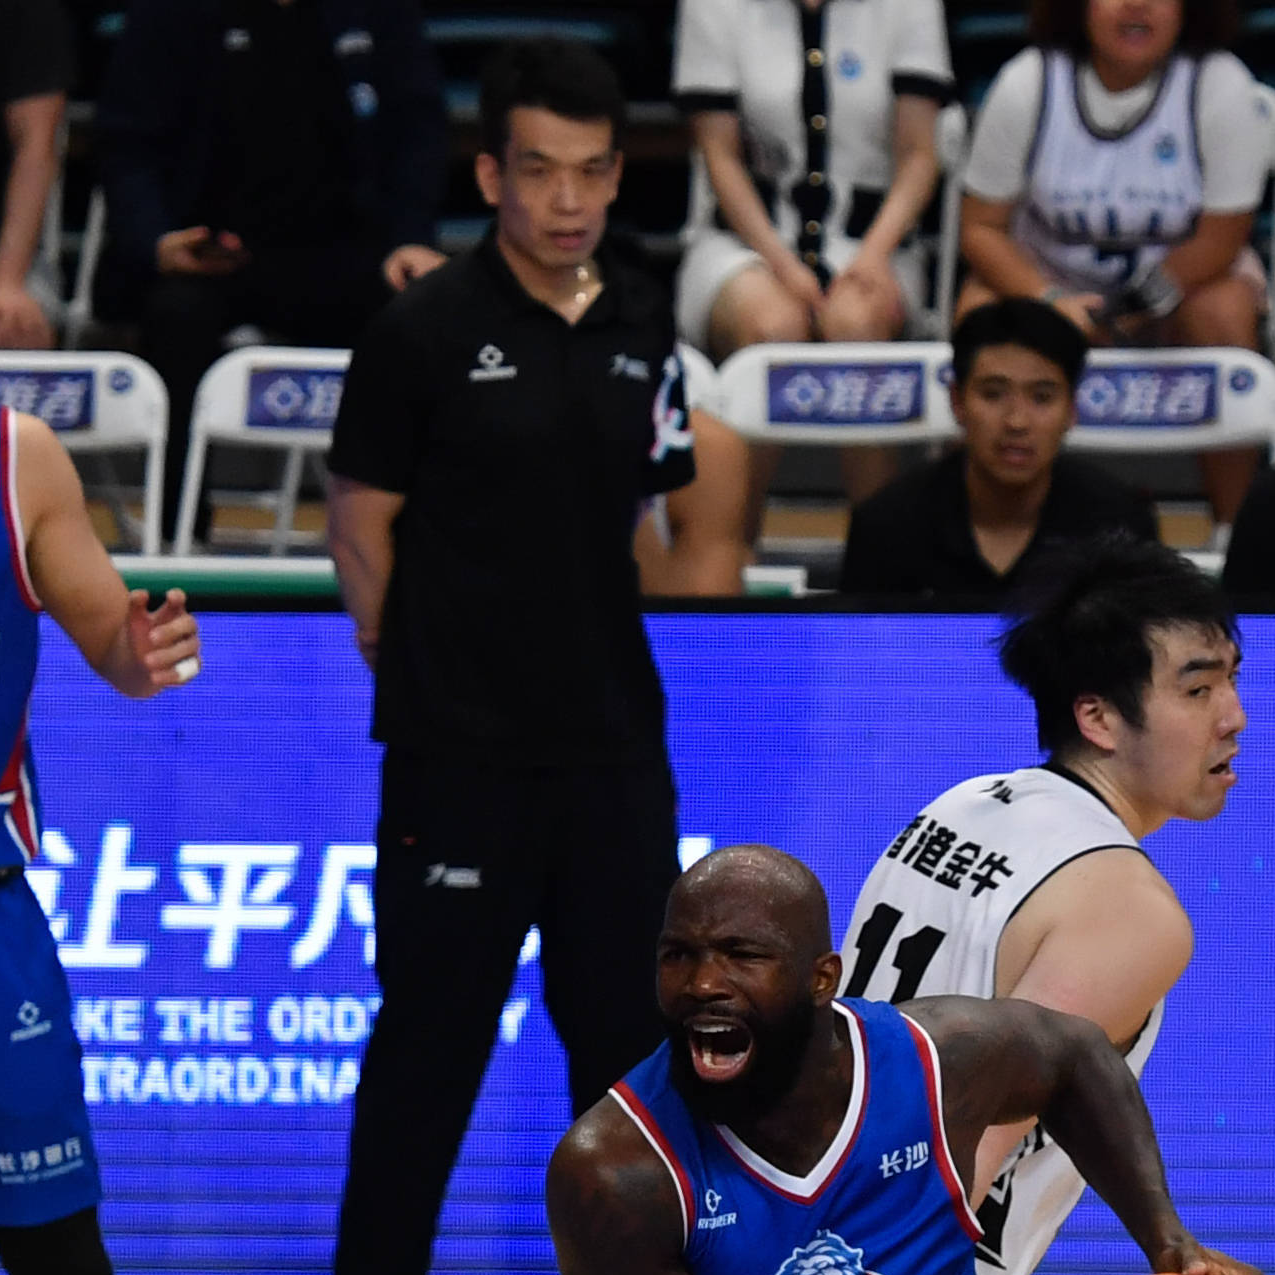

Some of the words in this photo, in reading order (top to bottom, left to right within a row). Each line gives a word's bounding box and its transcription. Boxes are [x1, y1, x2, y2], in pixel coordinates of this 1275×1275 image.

[843, 902, 946, 1000] 11
[156, 998, 254, 1042] THE
[879, 1141, 930, 1179] 长沙
